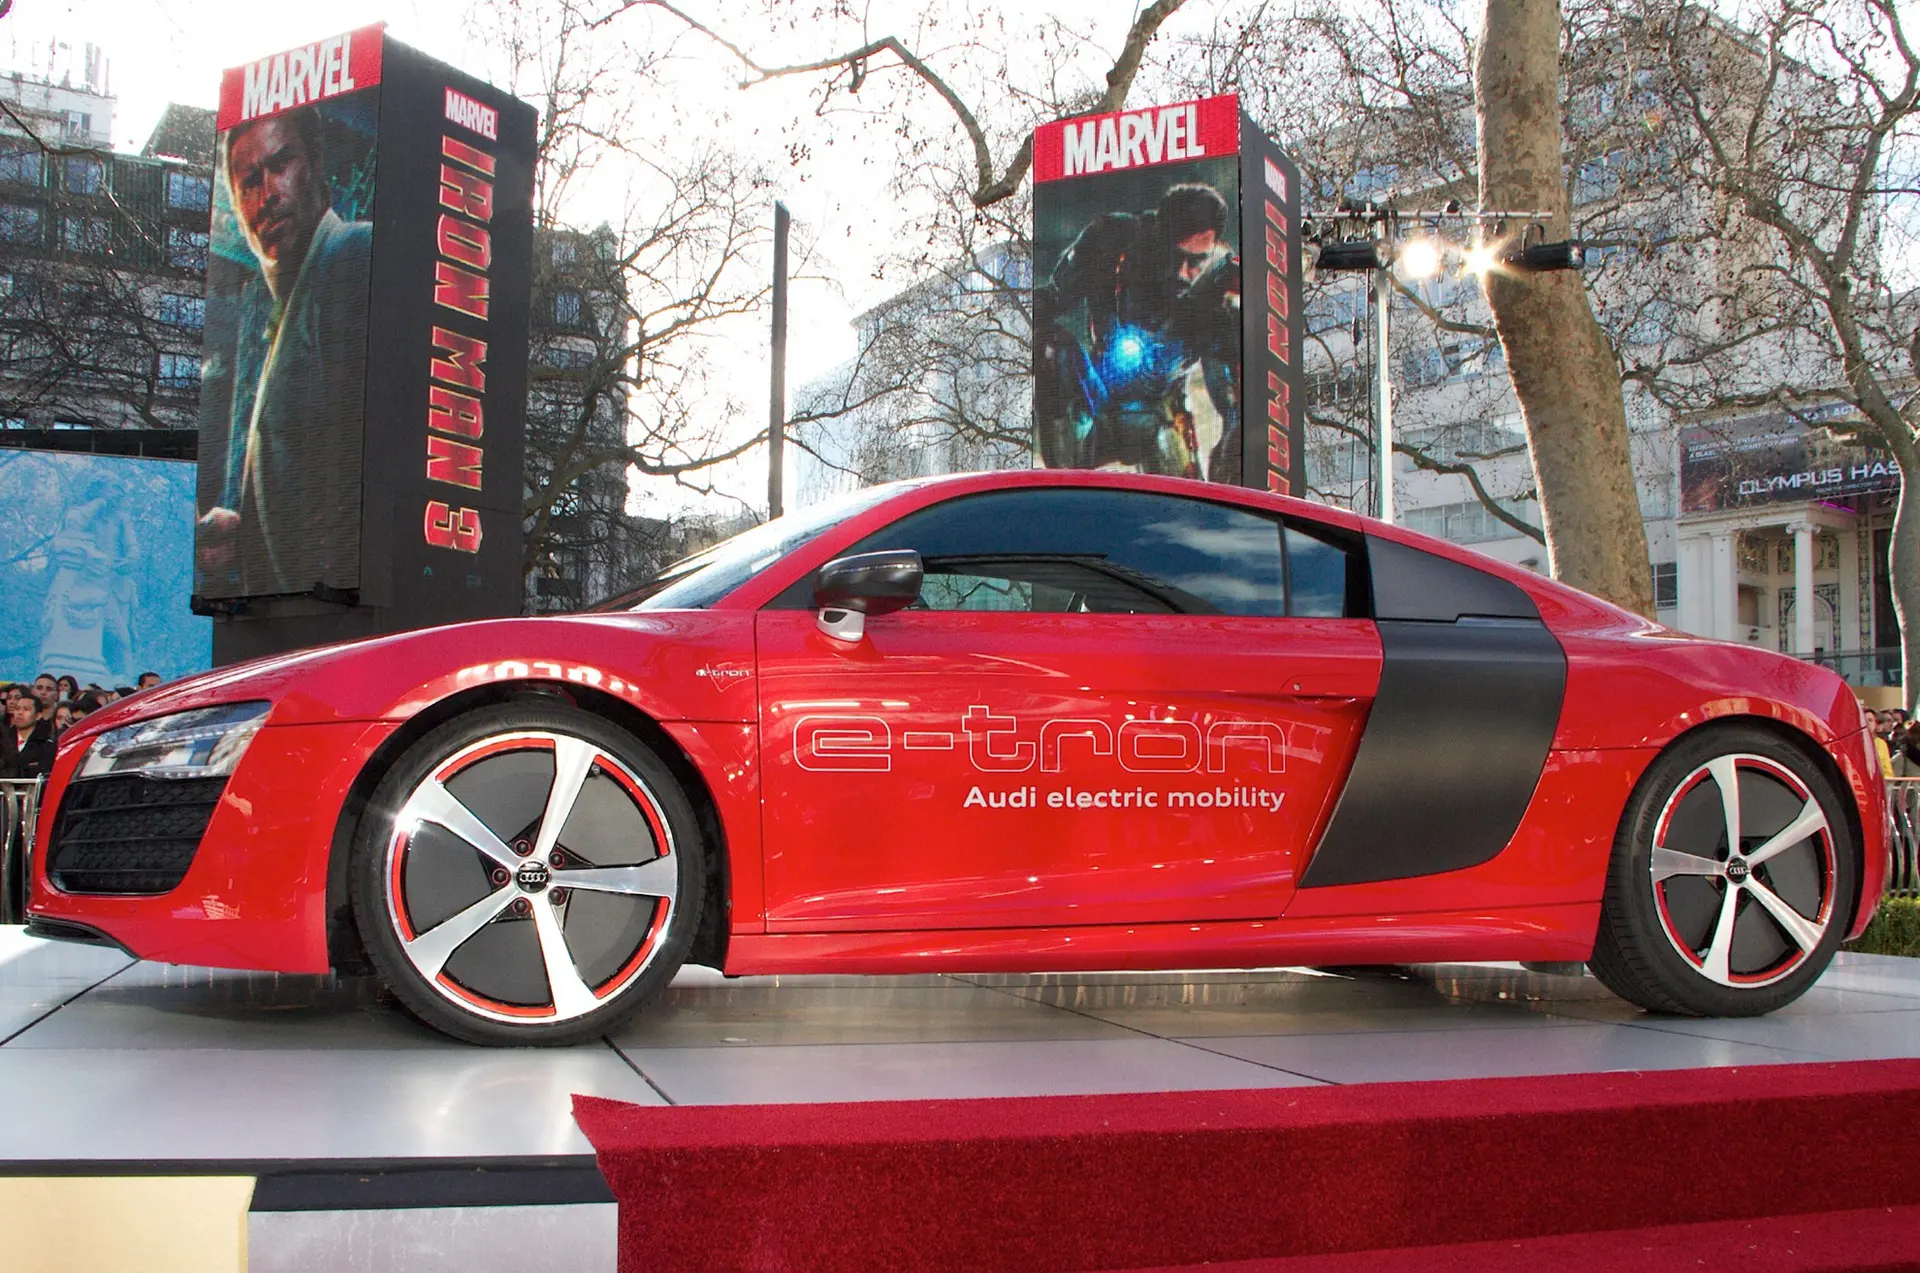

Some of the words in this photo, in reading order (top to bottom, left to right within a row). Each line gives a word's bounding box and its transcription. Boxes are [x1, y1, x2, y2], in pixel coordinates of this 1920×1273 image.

[241, 33, 355, 121] MARVEL
[446, 89, 497, 141] MARVEL
[1063, 104, 1206, 176] MARVEL
[434, 134, 496, 321] IRON
[1265, 199, 1289, 366] IRON
[427, 326, 487, 491] MAN
[1738, 467, 1843, 495] OLYMPUS
[1850, 460, 1901, 480] HAS
[423, 499, 484, 554] 3
[695, 668, 750, 677] e-tron
[793, 704, 1286, 774] e-tron
[963, 785, 1037, 809] Audi
[1046, 785, 1158, 809] electric
[1167, 785, 1286, 813] mobility
